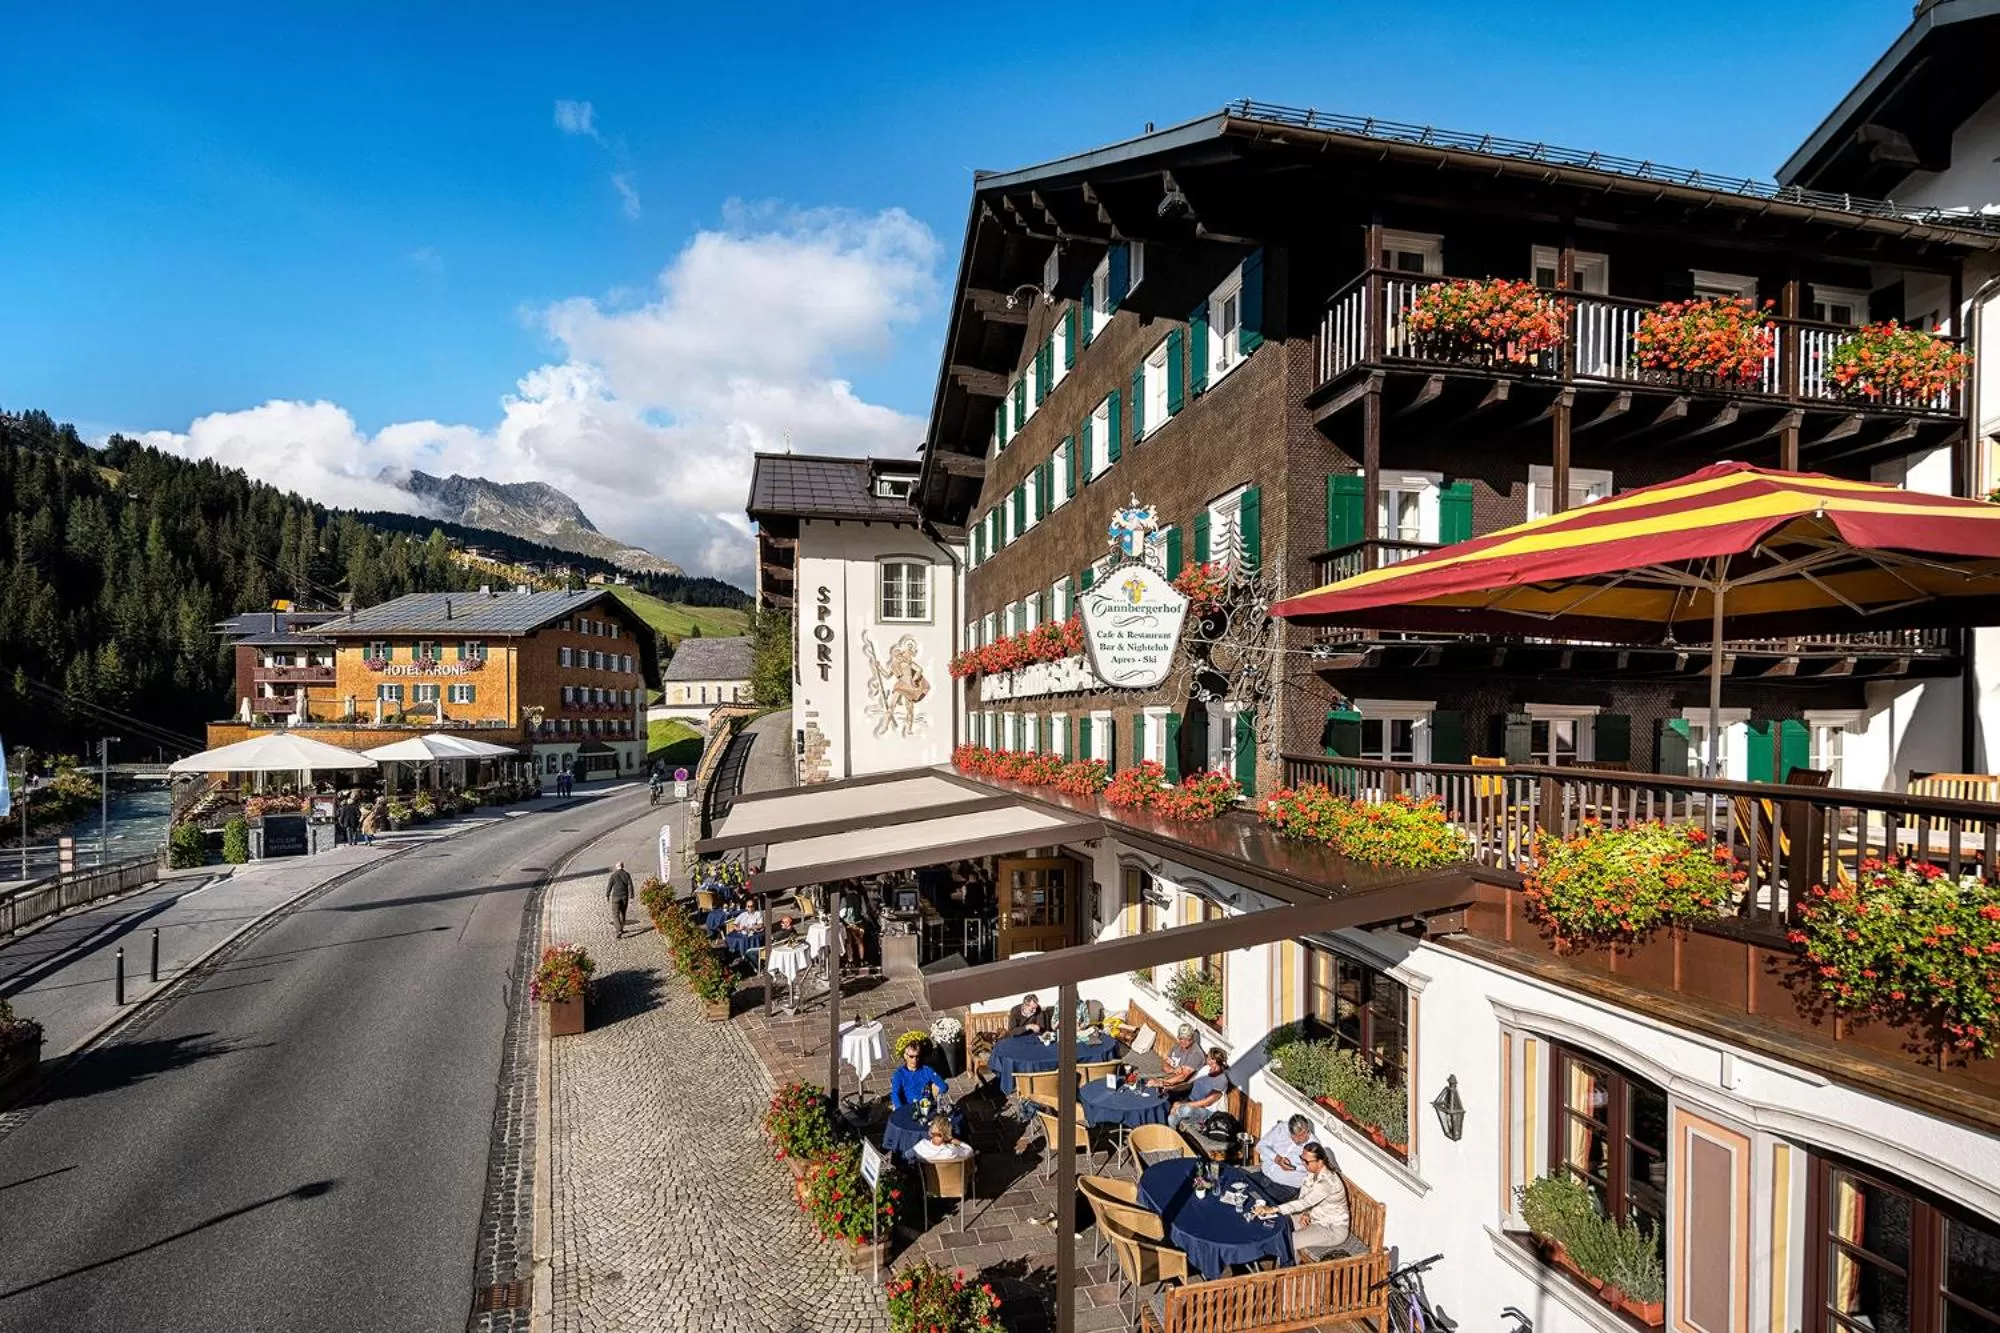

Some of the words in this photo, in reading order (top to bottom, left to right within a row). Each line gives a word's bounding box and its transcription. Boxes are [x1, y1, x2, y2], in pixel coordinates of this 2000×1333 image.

[1090, 594, 1183, 617] Tannbergerhof
[814, 585, 835, 682] SPORT
[1116, 631, 1124, 639] &
[1127, 631, 1172, 639] Restaurant
[1099, 643, 1115, 651] Bar
[1116, 643, 1125, 651] &
[1127, 643, 1169, 652] Nightclub
[1142, 655, 1157, 664] Ski
[383, 664, 421, 676] HOTEL
[425, 664, 468, 676] KRONE
